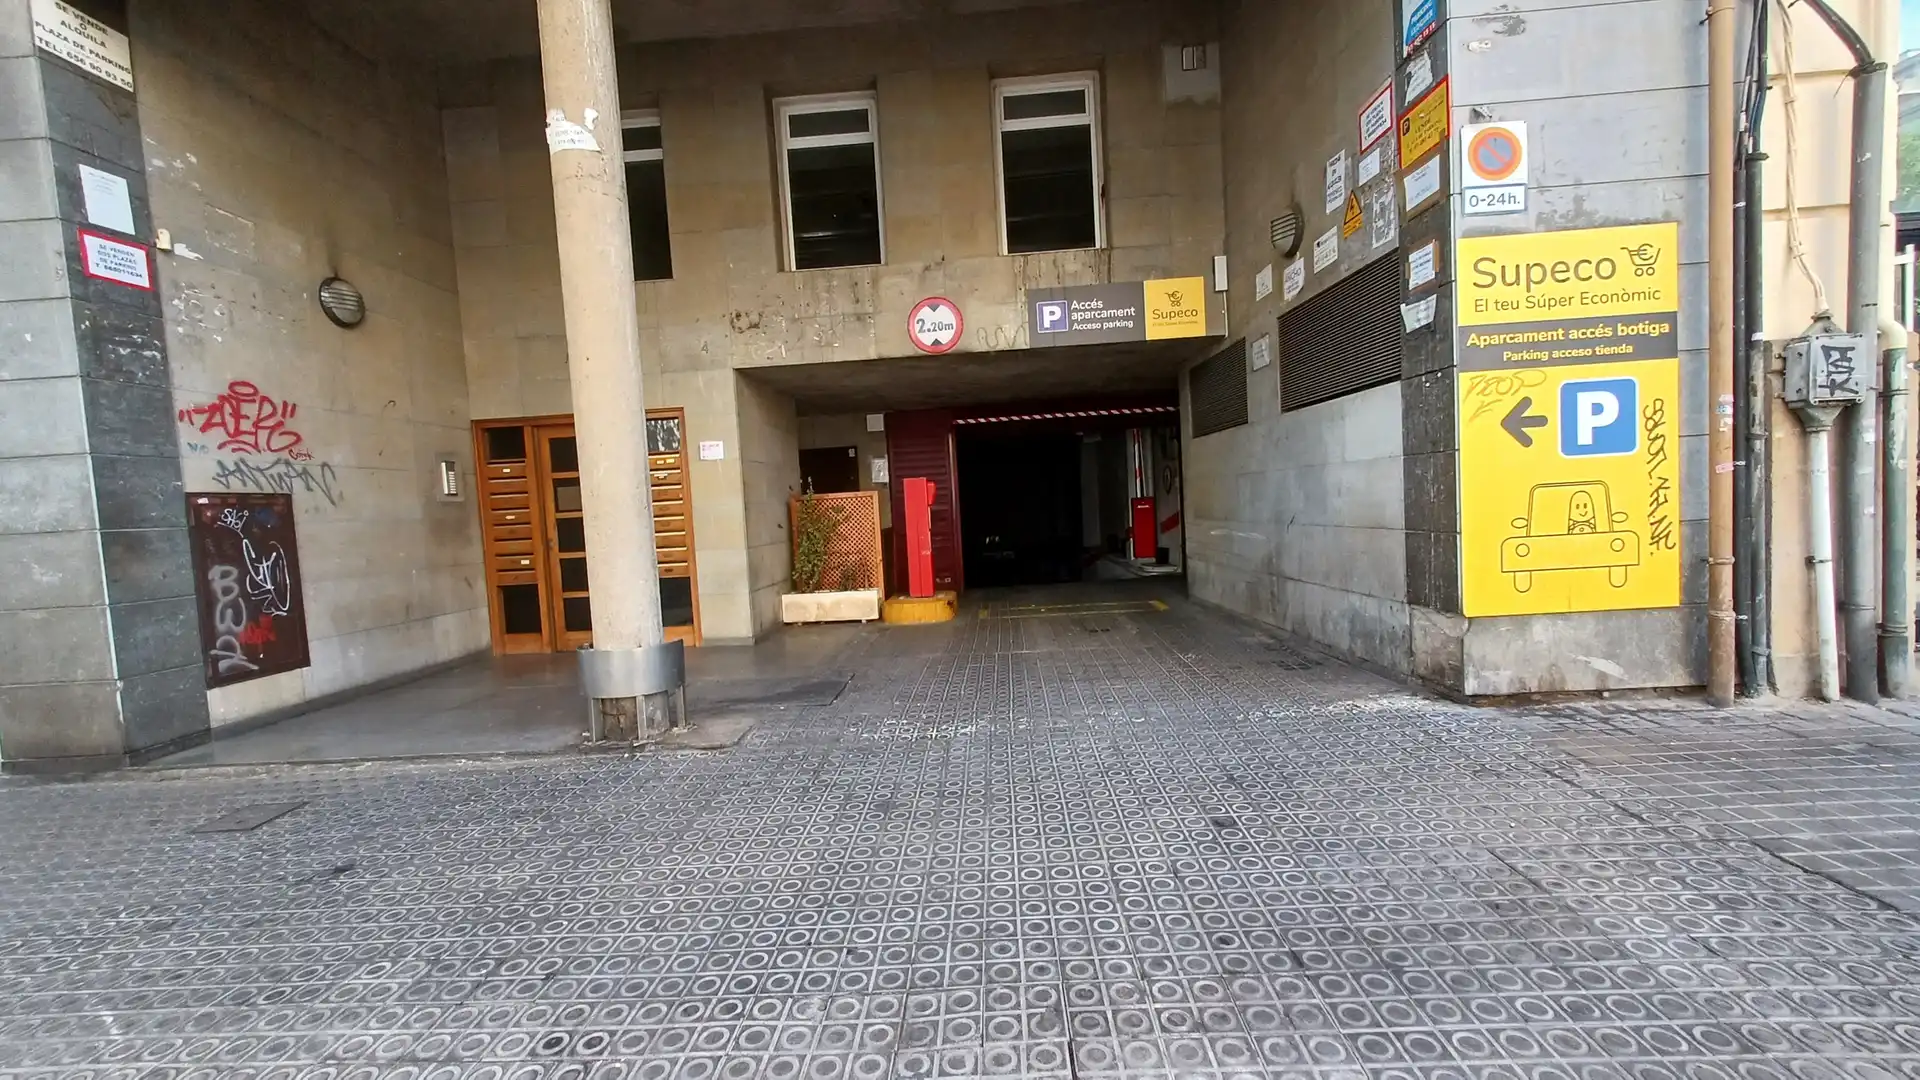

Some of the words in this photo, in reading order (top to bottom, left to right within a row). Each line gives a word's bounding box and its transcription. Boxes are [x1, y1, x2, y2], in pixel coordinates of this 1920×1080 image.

[54, 1, 69, 15] SE
[71, 10, 109, 36] VENDE
[79, 23, 88, 31] O
[60, 20, 108, 49] ALQUILA
[35, 21, 71, 44] PLAZA
[72, 40, 85, 51] DE
[88, 49, 132, 75] PARKING
[1469, 192, 1520, 208] 0-24h.
[1473, 256, 1617, 293] Supeco
[1071, 298, 1104, 311] Accés
[1474, 298, 1489, 313] El
[1494, 298, 1520, 311] teu
[1525, 293, 1575, 311] Súper
[1580, 287, 1661, 306] Econòmic
[1042, 305, 1062, 329] P
[1071, 306, 1136, 322] aparcament
[1072, 322, 1102, 331] Acceso
[1103, 319, 1134, 331] parking
[1152, 308, 1198, 321] Supeco
[1466, 327, 1565, 349] Aparcament
[1568, 323, 1613, 341] accés
[1617, 320, 1670, 337] botiga
[1503, 348, 1549, 362] Parking
[1552, 346, 1593, 359] acceso
[1595, 343, 1634, 356] tienda
[1577, 391, 1620, 446] P
